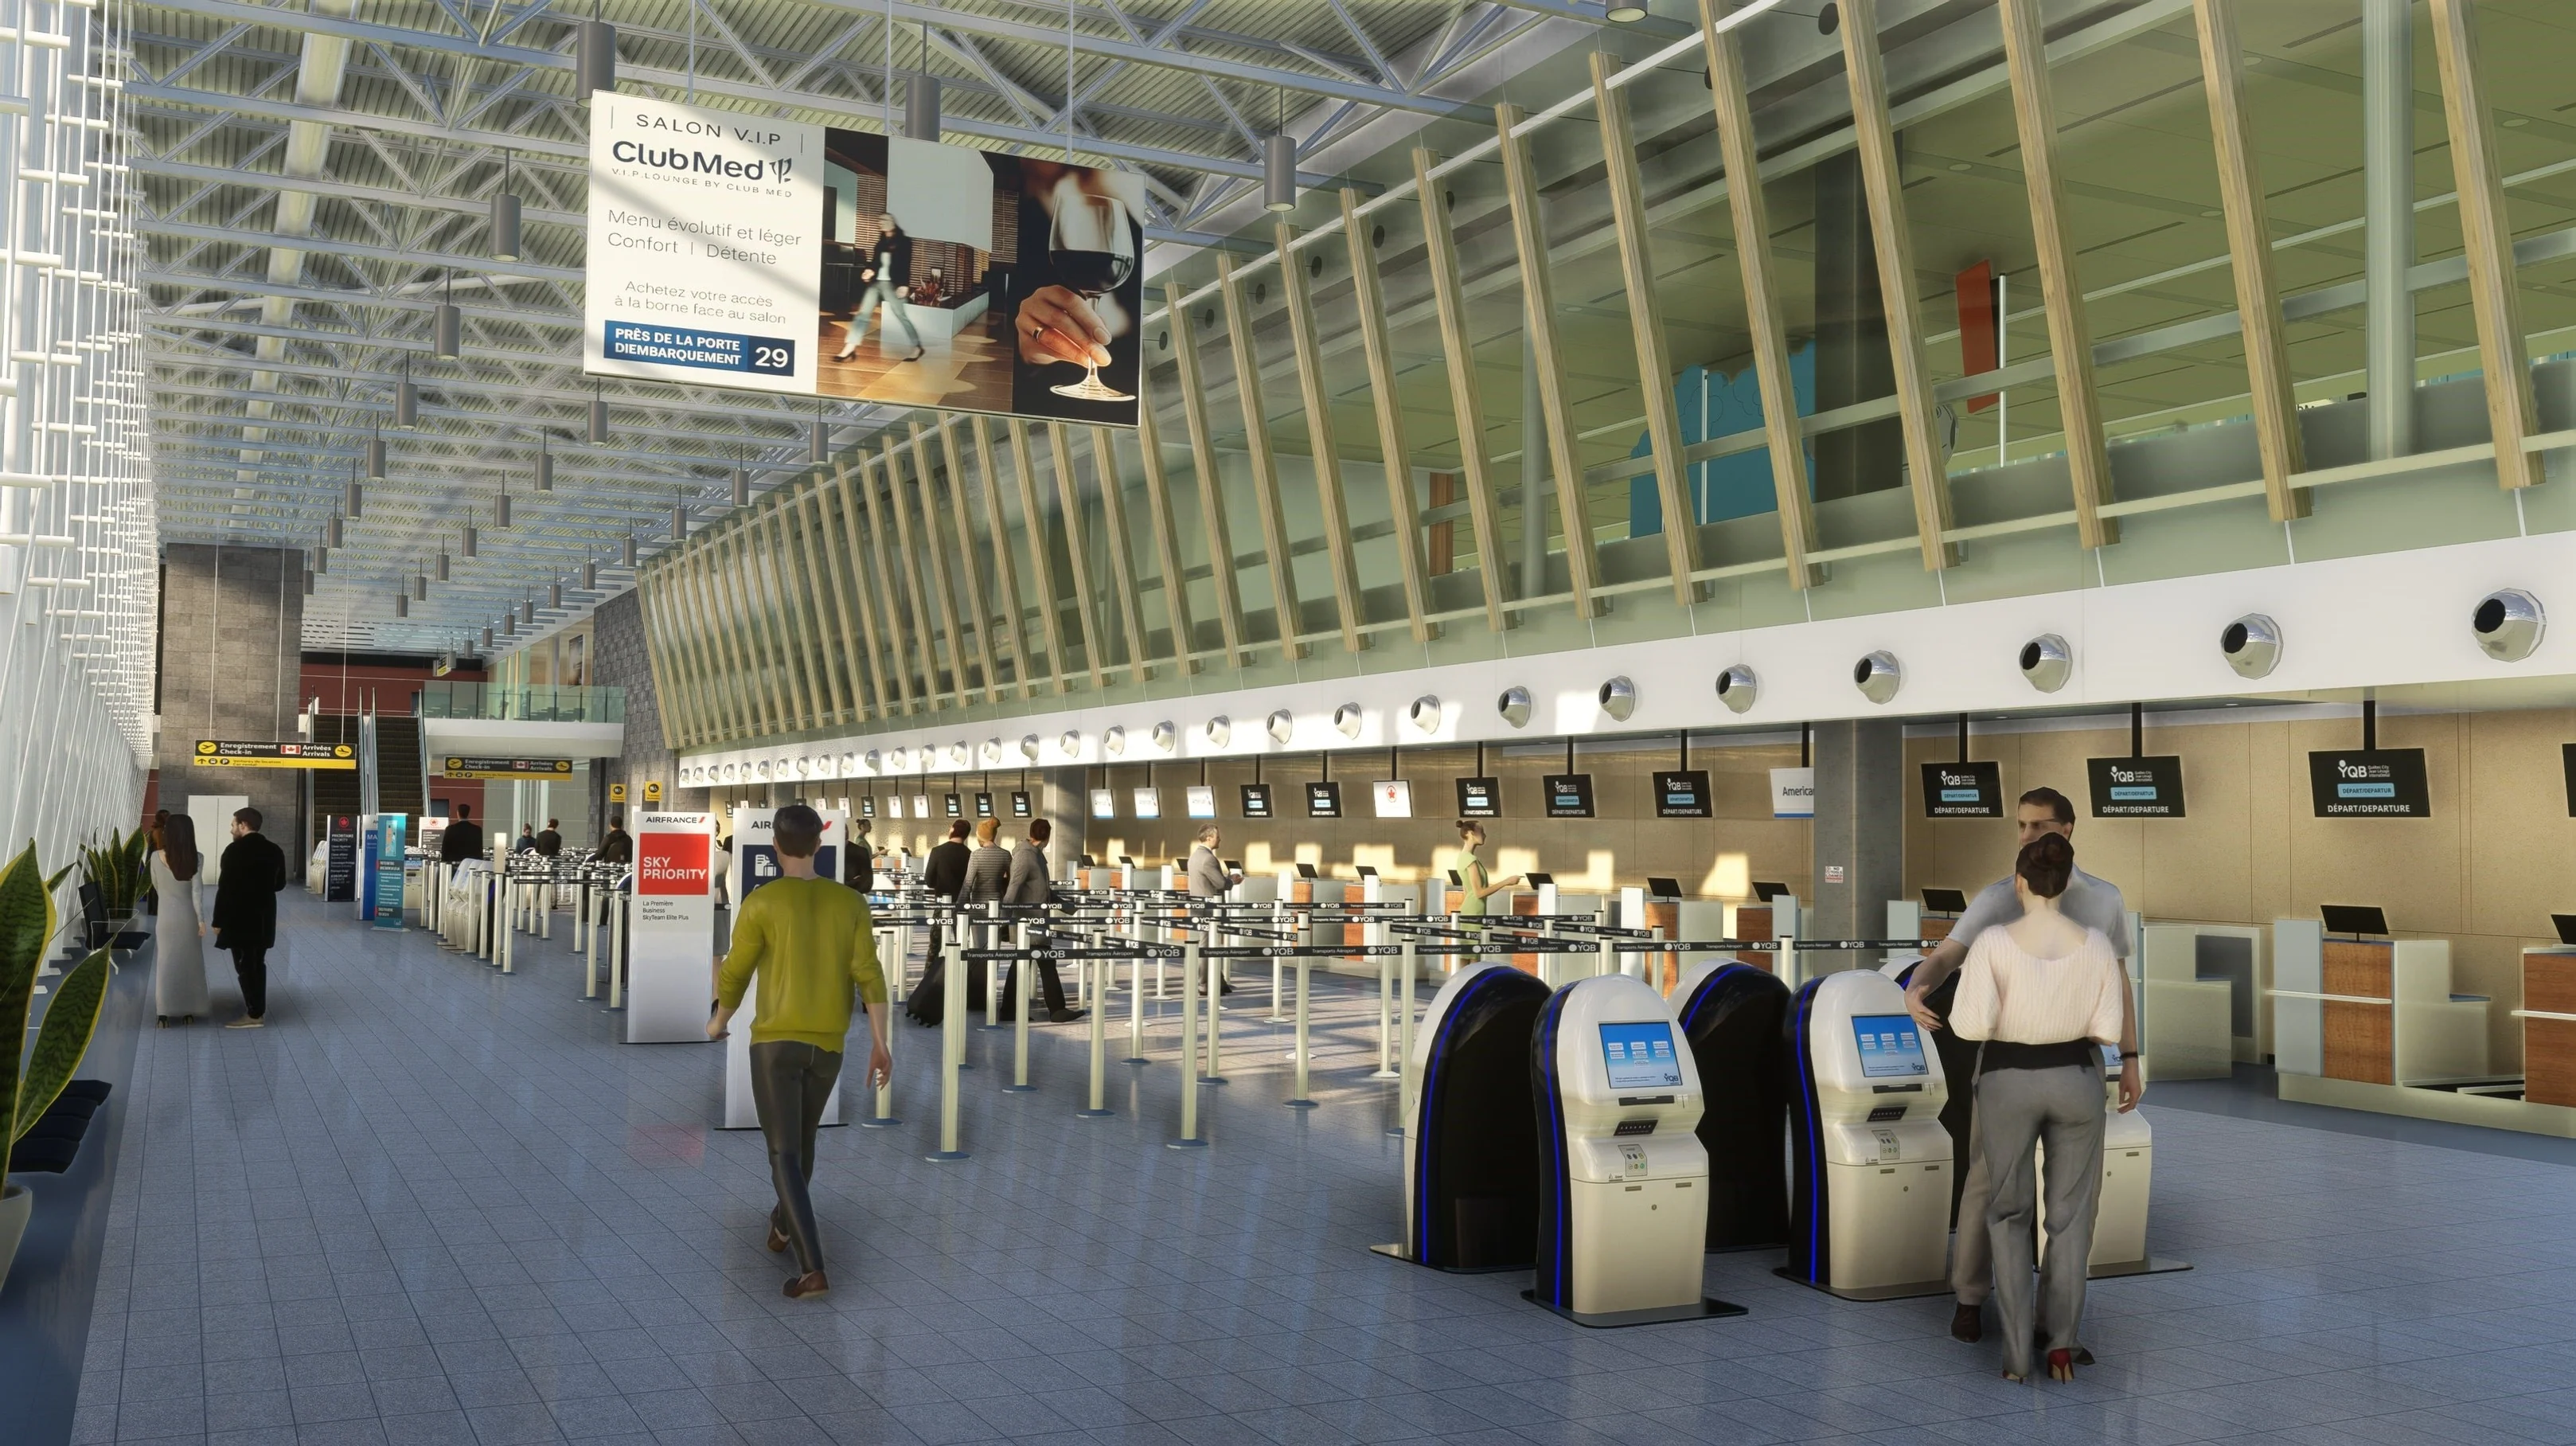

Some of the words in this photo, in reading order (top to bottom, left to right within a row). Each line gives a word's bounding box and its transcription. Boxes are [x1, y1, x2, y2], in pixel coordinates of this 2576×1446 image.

[637, 115, 720, 137] SALON
[727, 183, 759, 193] CLUB
[766, 189, 791, 197] MED
[609, 209, 661, 229] Menu
[668, 217, 732, 237] évolutif
[737, 228, 753, 240] et
[759, 229, 802, 247] léger
[608, 233, 677, 253] Confort
[707, 244, 776, 264] Détente
[625, 281, 685, 298] Achetez
[691, 290, 726, 302] votre
[732, 293, 772, 307] accès
[615, 295, 623, 307] à
[629, 297, 640, 308] la
[646, 299, 688, 313] borne
[693, 303, 724, 317] face
[728, 311, 744, 319] au
[749, 312, 786, 324] salon
[654, 332, 672, 344] DE
[677, 335, 693, 346] LA
[697, 337, 740, 351] PORTE
[755, 347, 788, 368] 29
[2110, 768, 2134, 782] YQB
[2338, 763, 2367, 778] YQB
[1667, 780, 1681, 790] YQB
[1941, 773, 1961, 785] YQB
[2328, 803, 2410, 813] DÉPART/DEPARTURE
[643, 857, 670, 867] SKY
[643, 869, 707, 879] PRIORITY
[1043, 950, 1065, 959] YQB
[1664, 1073, 1678, 1082] YQB
